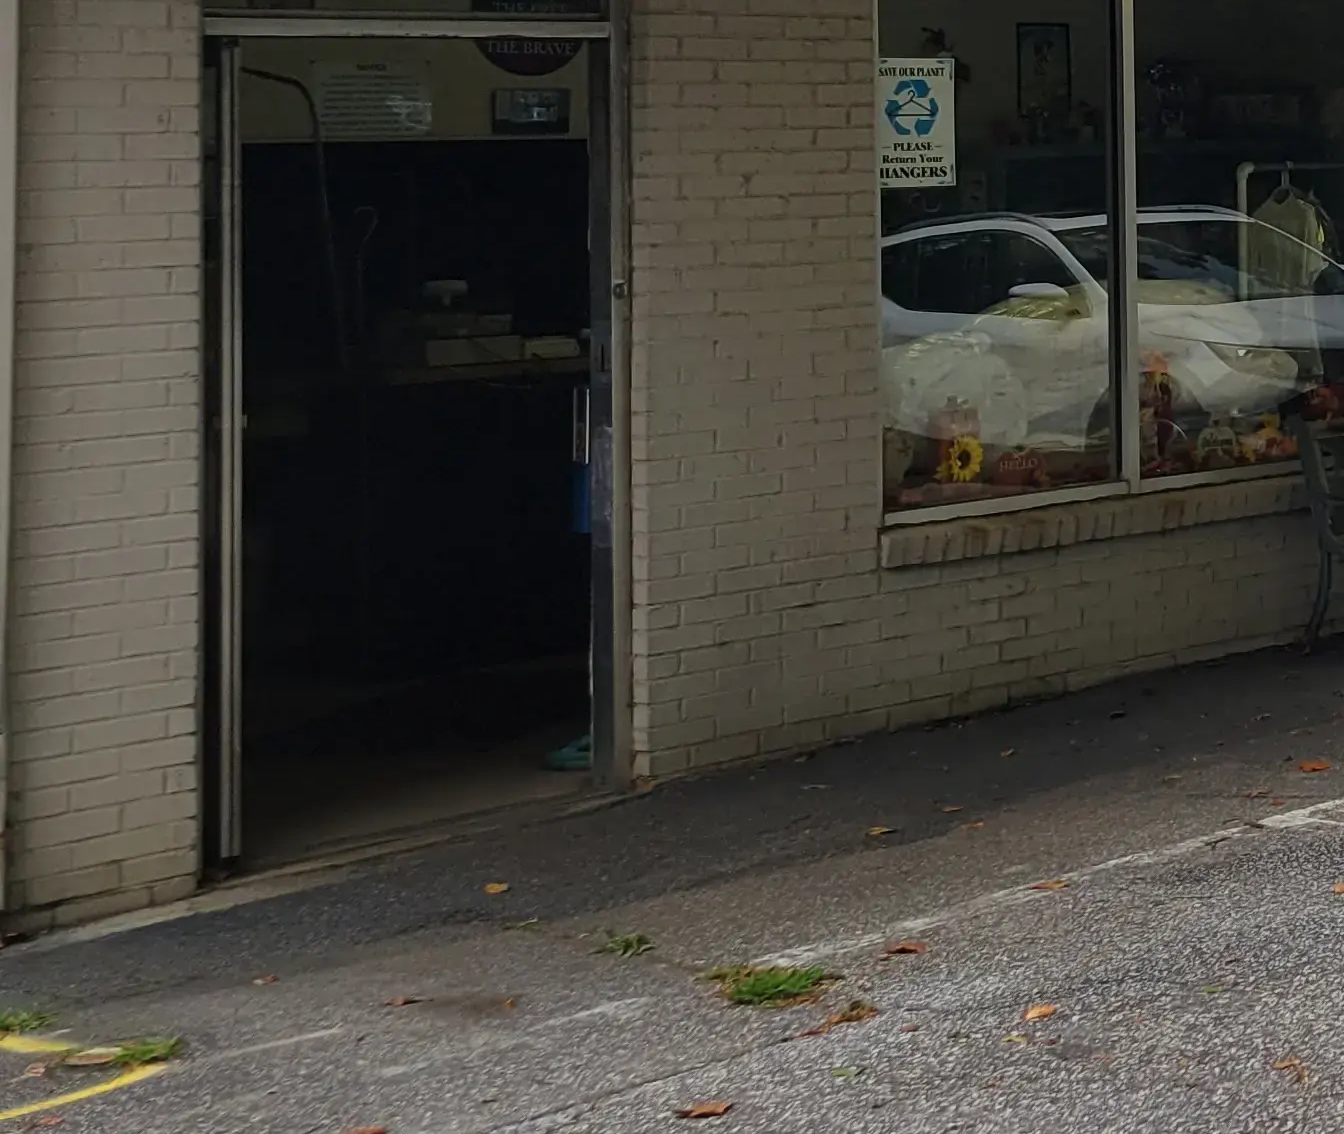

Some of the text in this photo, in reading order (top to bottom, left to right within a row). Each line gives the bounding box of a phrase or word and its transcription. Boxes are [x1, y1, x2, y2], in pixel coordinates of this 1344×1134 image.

[878, 67, 946, 77] SAVE OUR PLANET
[893, 142, 934, 152] PLEASE
[882, 154, 944, 164] Return Your
[880, 166, 948, 179] HANGERS
